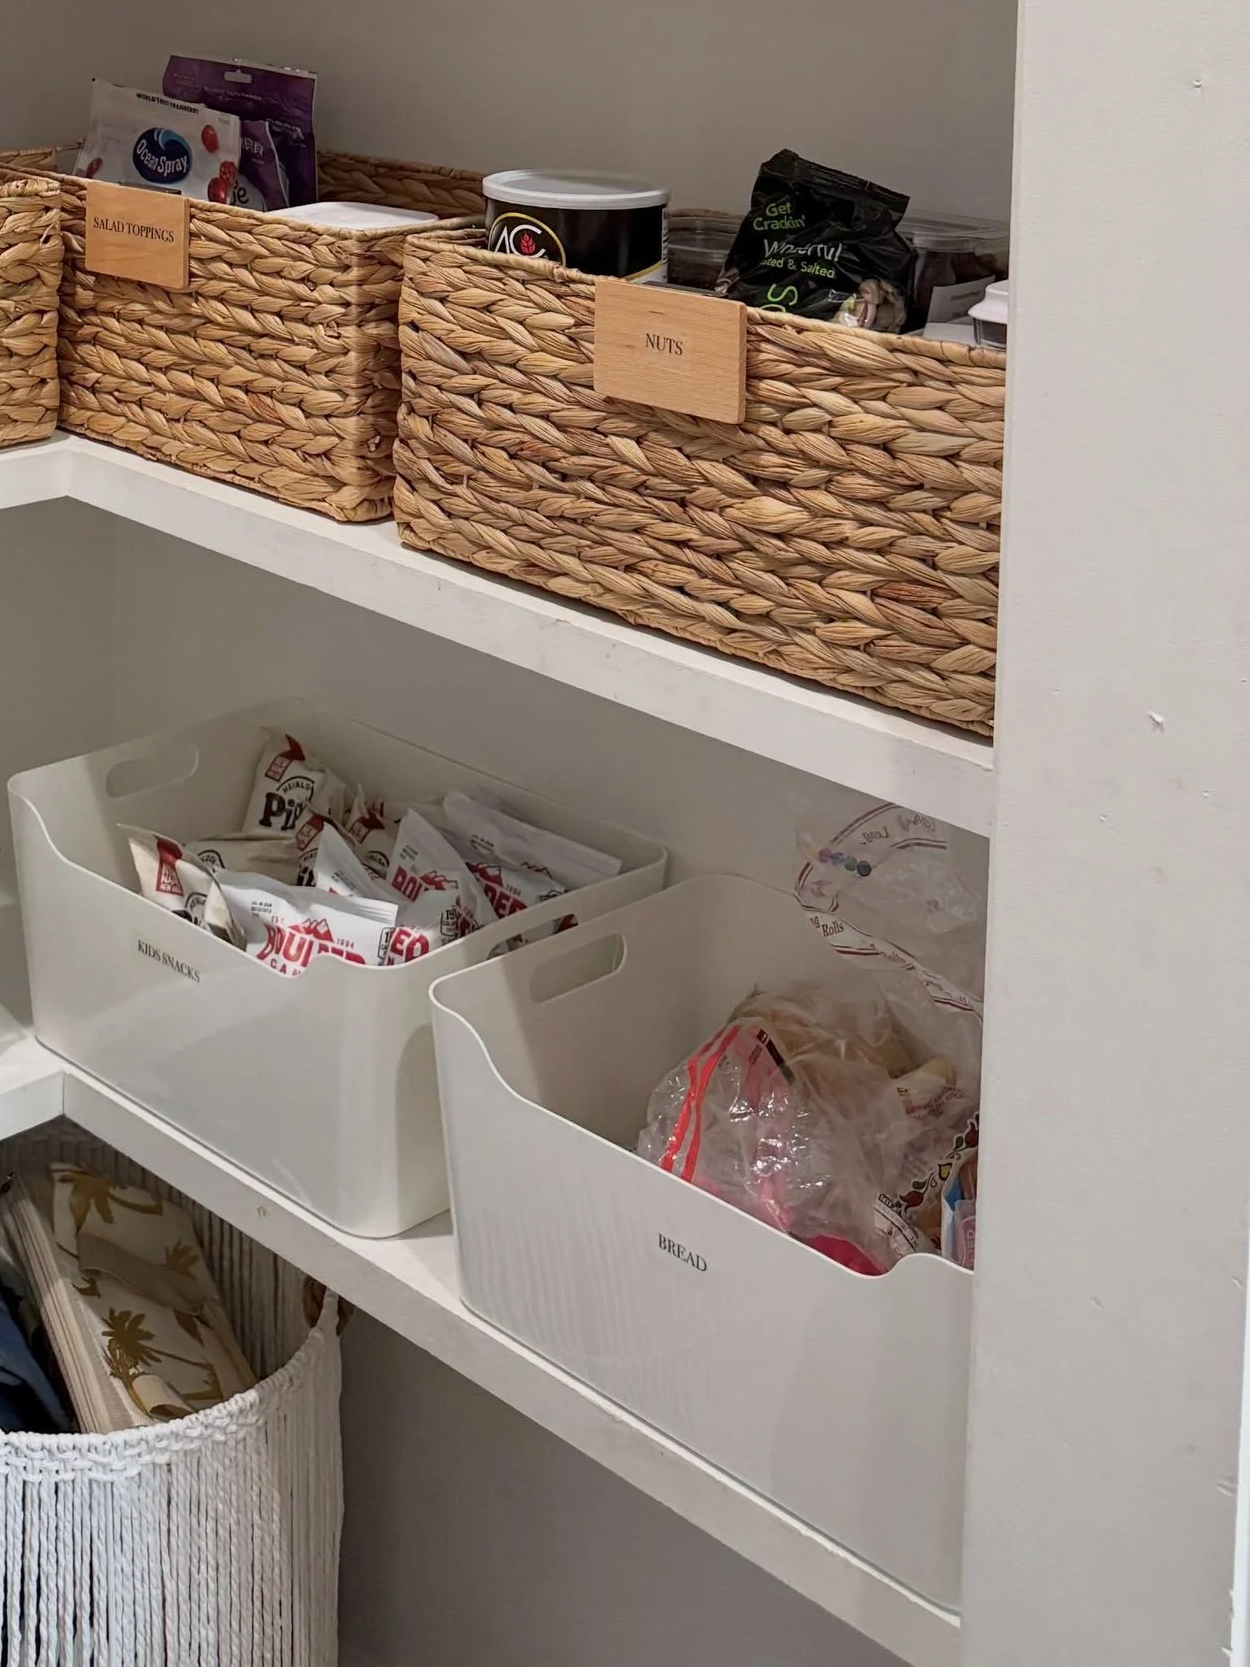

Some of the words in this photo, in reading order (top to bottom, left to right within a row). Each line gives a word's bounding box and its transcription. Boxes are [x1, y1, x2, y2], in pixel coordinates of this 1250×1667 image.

[136, 140, 158, 172] Ocean
[158, 155, 188, 177] Spray
[766, 202, 792, 217] Get
[93, 216, 125, 234] SALAD
[127, 222, 175, 243] TOPPINGS
[752, 215, 806, 231] Crackin'
[787, 258, 797, 270] &
[800, 261, 835, 279] Salted
[645, 333, 684, 356] NUTS
[822, 921, 845, 937] Rolls
[337, 937, 355, 950] 1994
[137, 939, 161, 963] KIDS
[162, 952, 201, 983] SNACKS
[656, 1232, 708, 1273] BREAD
